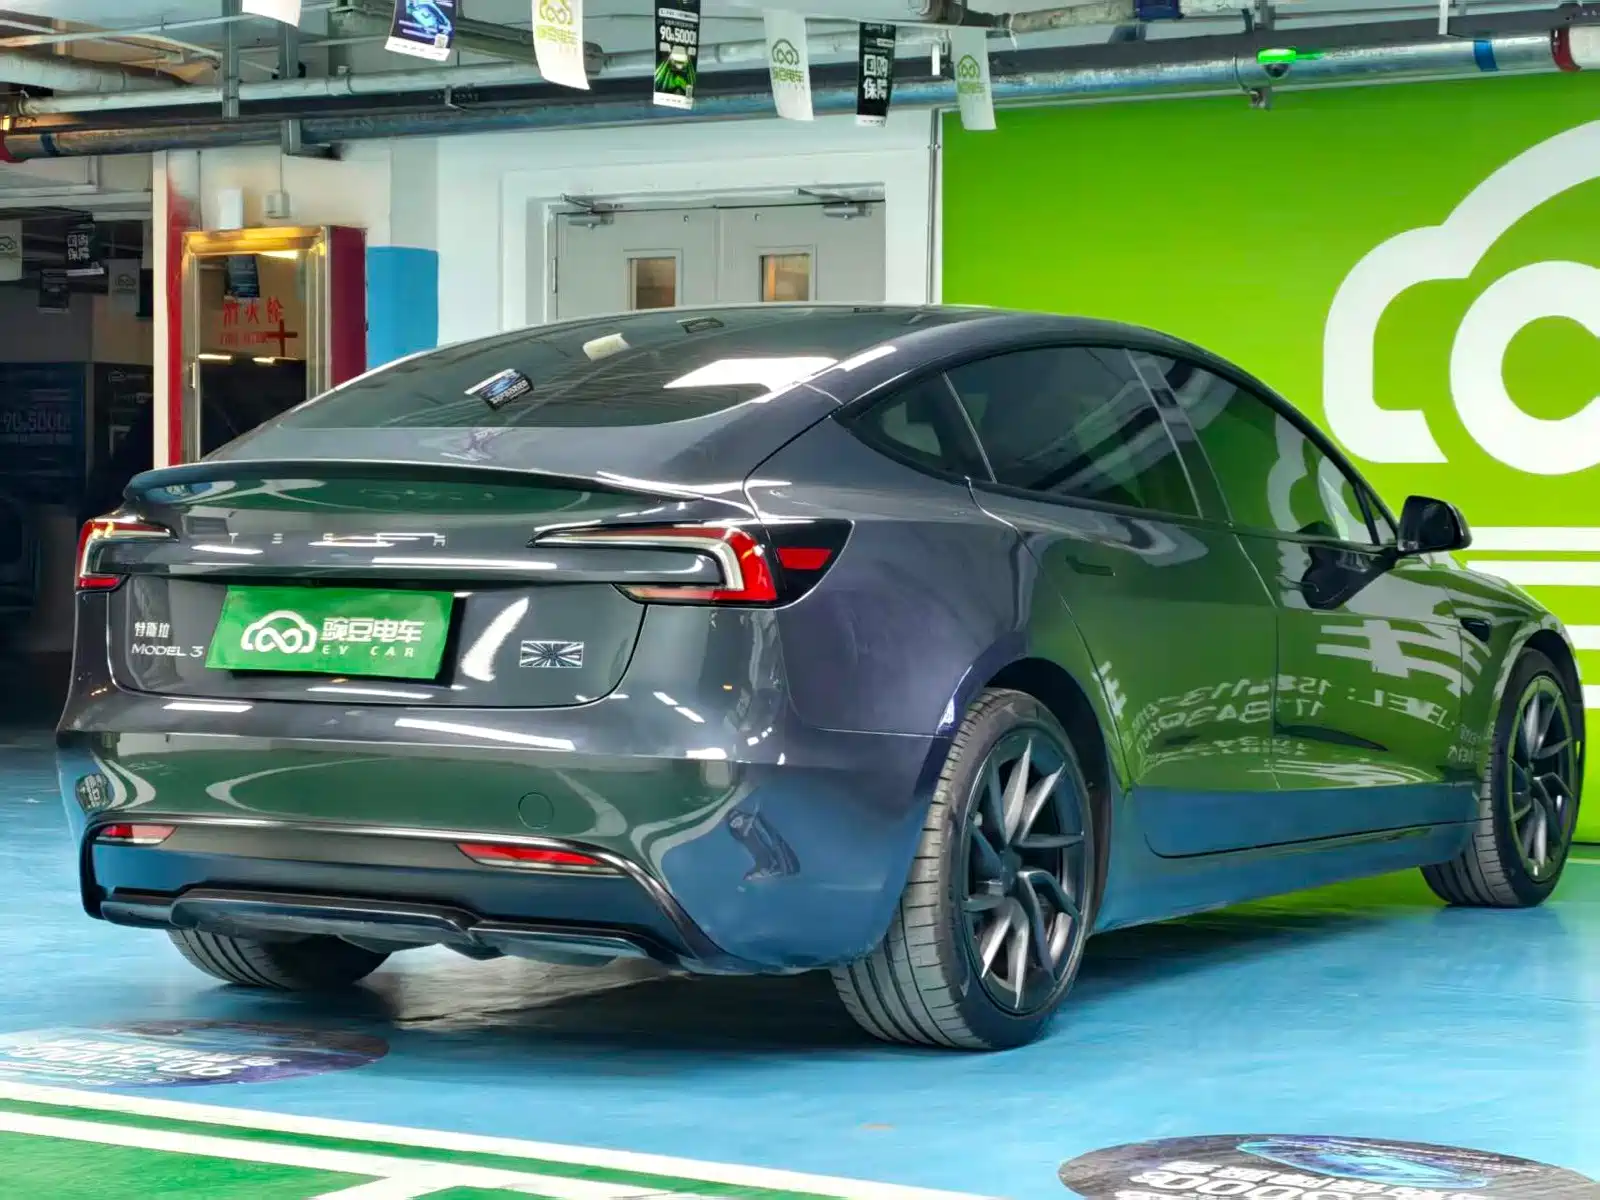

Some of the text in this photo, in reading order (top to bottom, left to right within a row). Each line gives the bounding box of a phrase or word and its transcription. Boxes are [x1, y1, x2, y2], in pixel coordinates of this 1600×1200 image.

[134, 621, 171, 638] 特斯拉
[320, 616, 425, 643] 豌豆电车
[131, 643, 205, 658] MODEL 3
[322, 644, 414, 658] EV CAR
